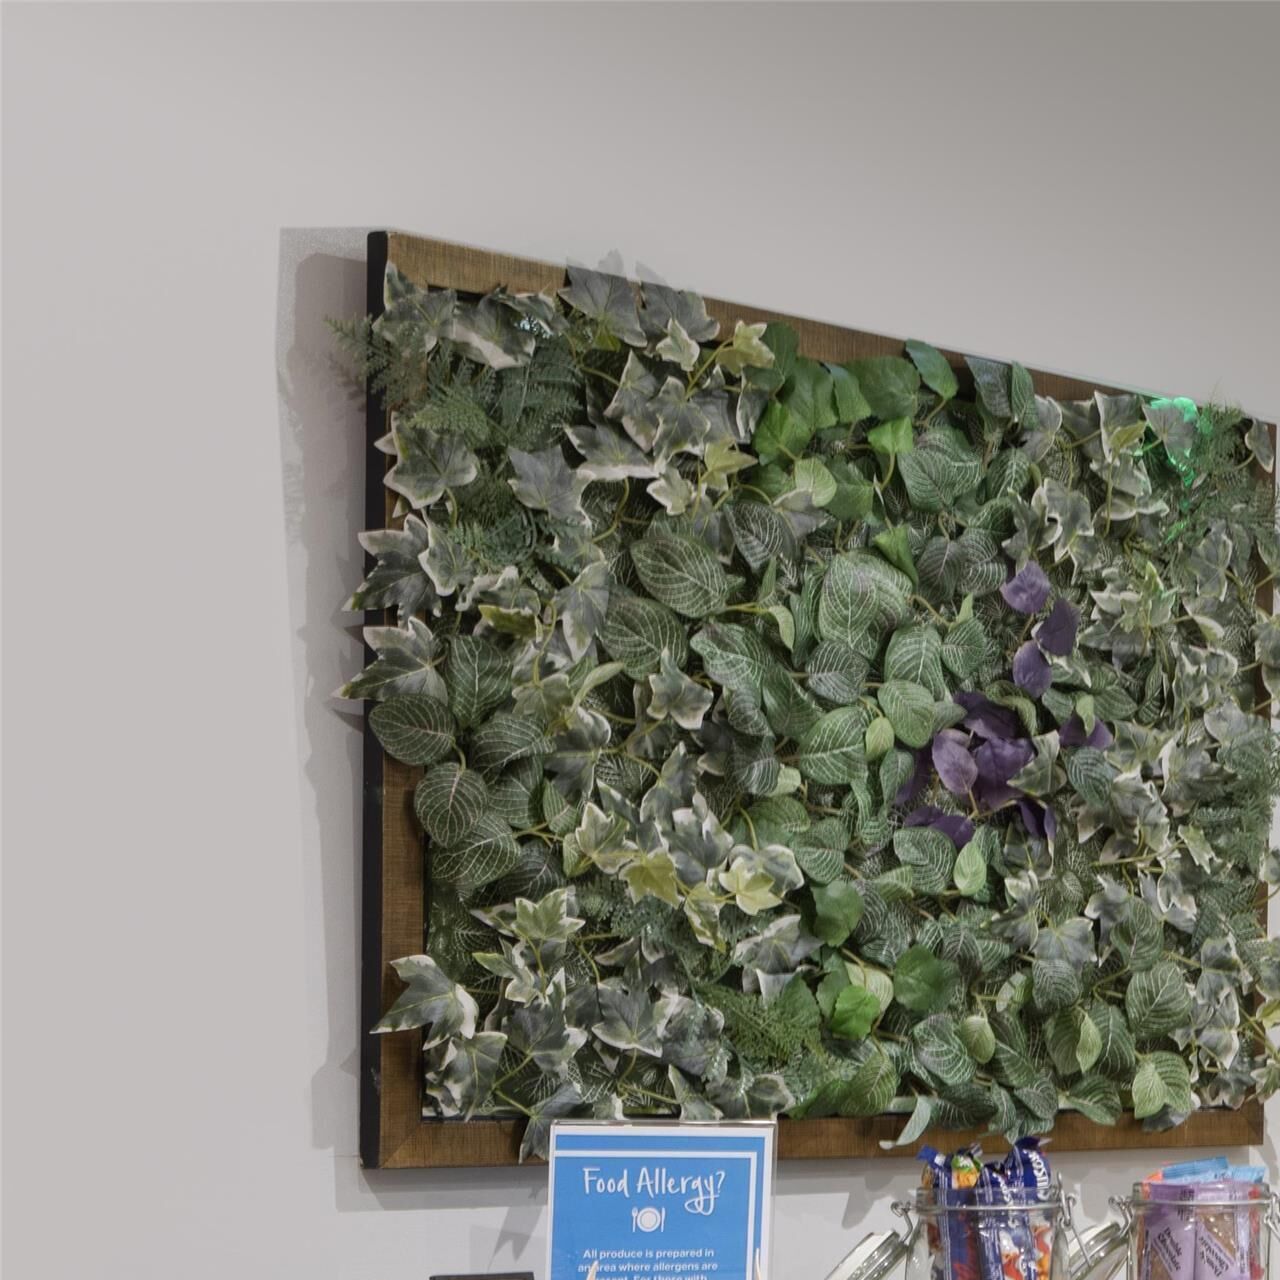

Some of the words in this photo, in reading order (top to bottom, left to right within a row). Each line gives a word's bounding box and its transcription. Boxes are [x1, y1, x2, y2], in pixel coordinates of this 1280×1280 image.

[583, 1167, 630, 1198] Food
[636, 1166, 726, 1216] Allergy?
[583, 1249, 598, 1258] All
[600, 1249, 643, 1260] produce
[645, 1249, 653, 1258] is
[656, 1249, 703, 1260] prepared
[705, 1248, 715, 1257] in
[578, 1264, 590, 1273] an
[596, 1263, 616, 1273] rea
[619, 1262, 650, 1272] where
[653, 1262, 700, 1275] allergens
[702, 1263, 718, 1271] are
